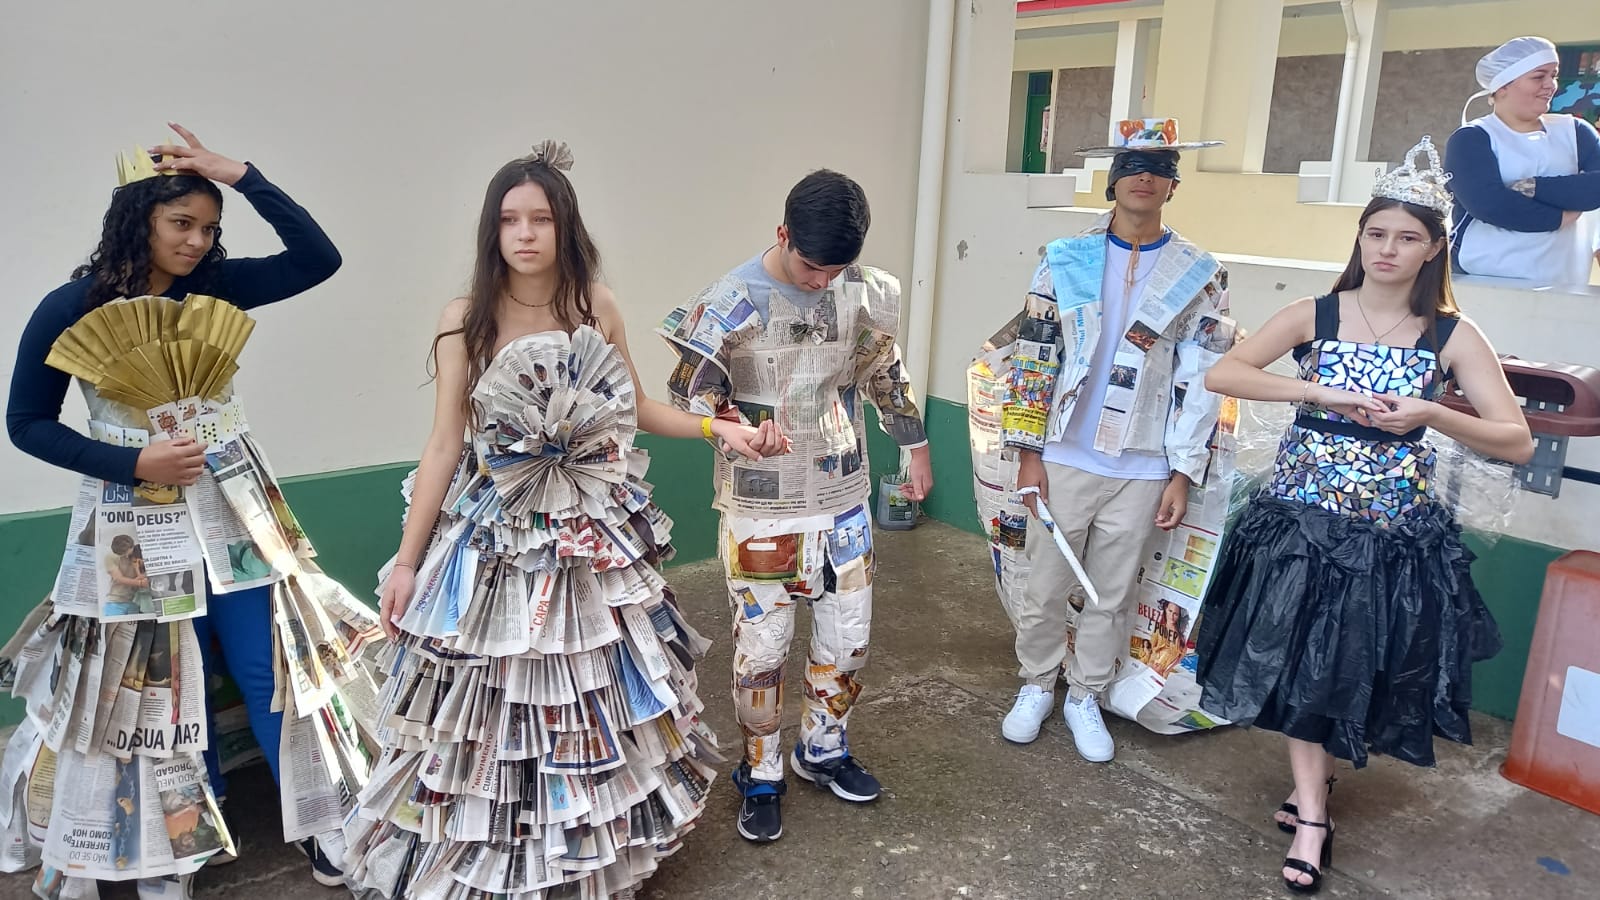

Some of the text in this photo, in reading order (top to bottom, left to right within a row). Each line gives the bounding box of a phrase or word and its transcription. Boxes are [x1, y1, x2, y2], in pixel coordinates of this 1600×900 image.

[137, 511, 187, 526] DEUS?"
[533, 600, 550, 625] CAPA
[134, 727, 165, 750] SUA
[483, 761, 495, 791] CURSOS
[90, 830, 112, 839] COMO
[70, 839, 110, 851] ENFRENTE
[80, 852, 91, 860] SE
[92, 853, 108, 864] NÃO
